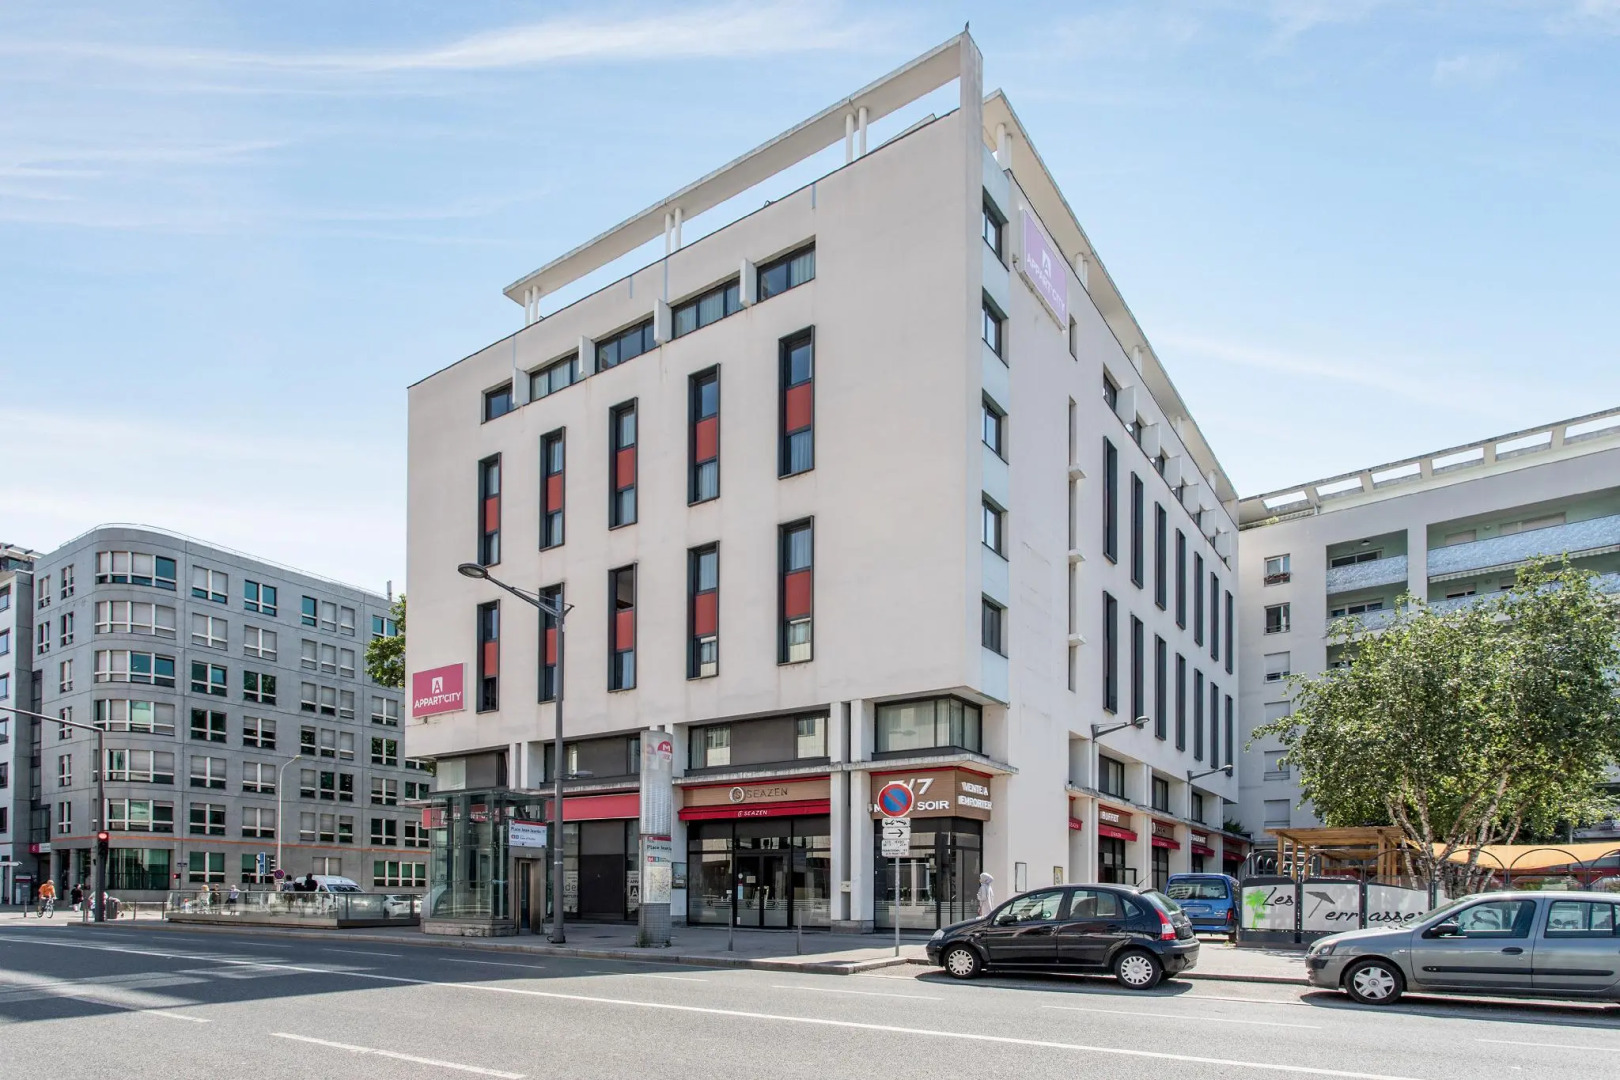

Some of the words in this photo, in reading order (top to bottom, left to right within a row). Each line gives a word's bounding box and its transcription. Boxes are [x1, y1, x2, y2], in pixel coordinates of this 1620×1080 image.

[414, 691, 462, 709] APPART'CITY
[746, 787, 788, 799] SEAZEN
[917, 800, 950, 811] SOIR
[743, 809, 768, 817] SEAZEN
[1262, 887, 1295, 907] Les
